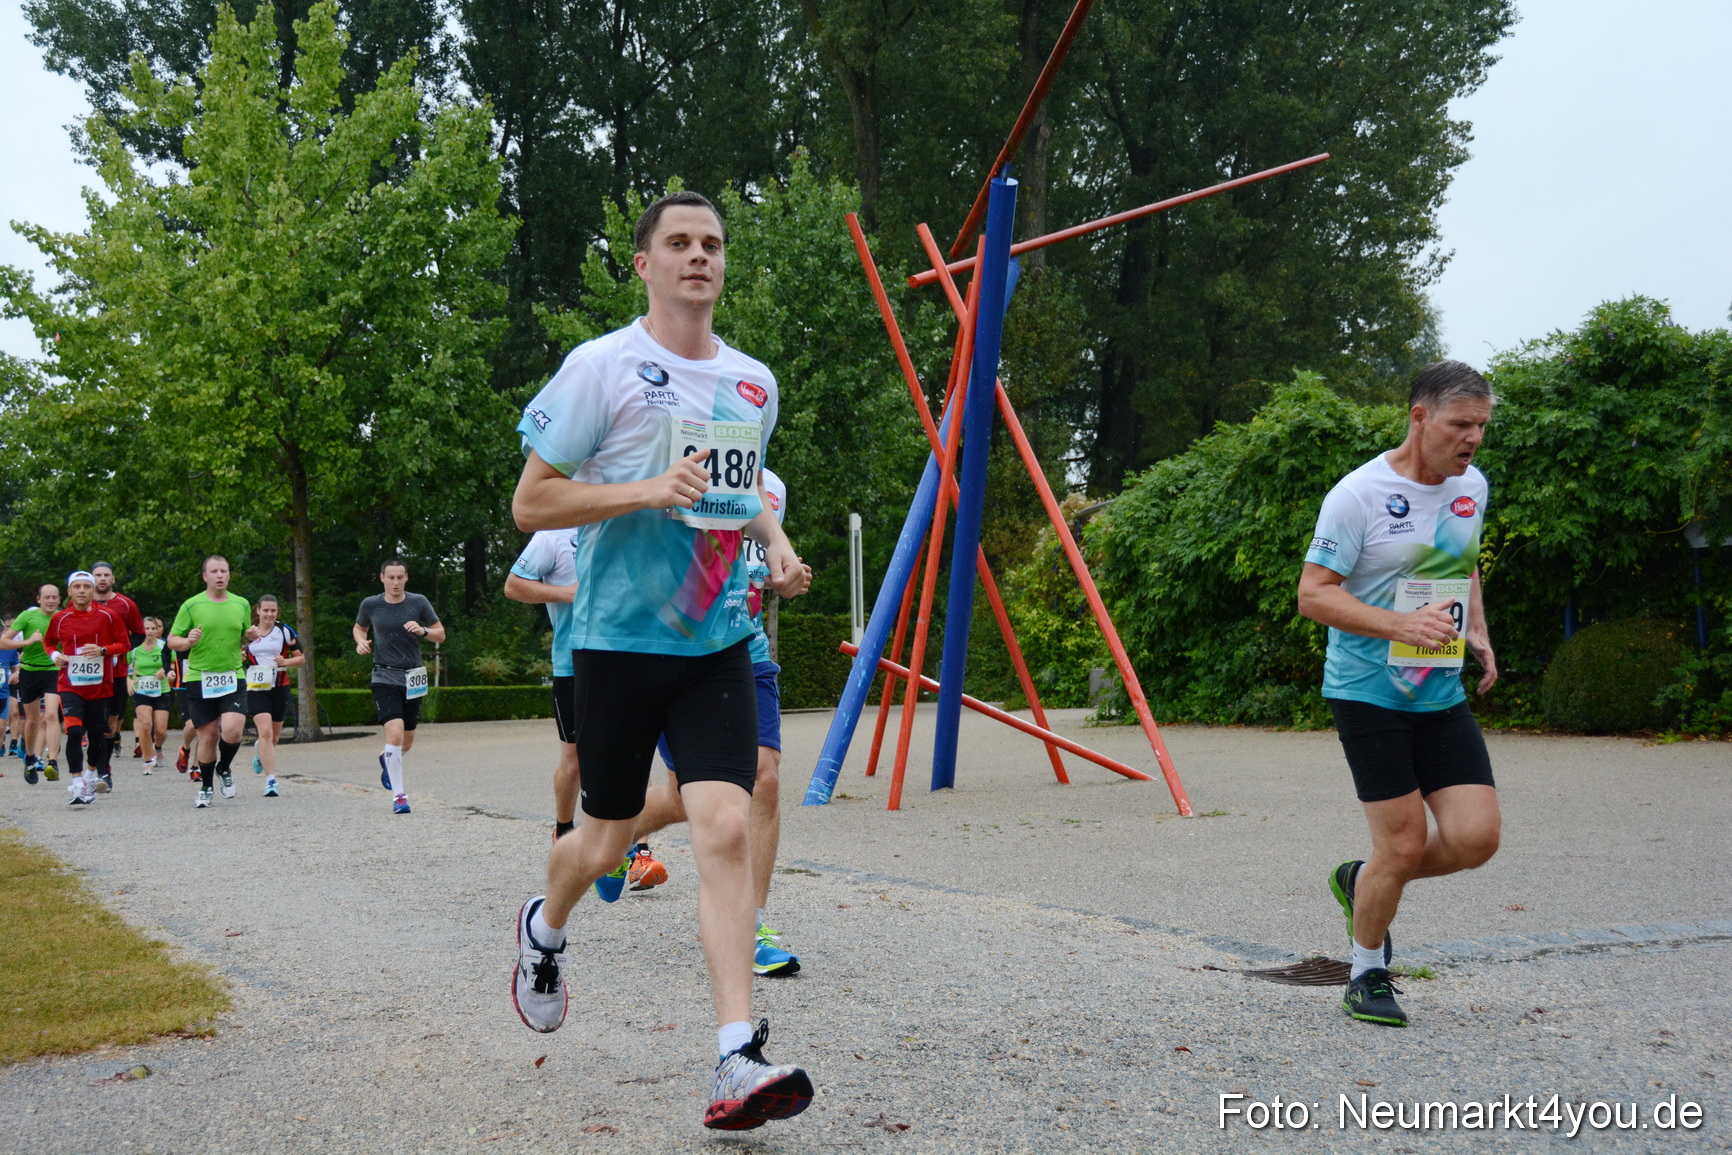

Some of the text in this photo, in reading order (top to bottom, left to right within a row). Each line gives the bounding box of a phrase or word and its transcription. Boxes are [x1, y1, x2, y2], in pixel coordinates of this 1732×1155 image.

[643, 390, 679, 402] PARTL
[714, 425, 760, 441] BOCK
[691, 498, 747, 515] Christian
[1389, 521, 1415, 530] PARTL
[1389, 528, 1416, 536] Neumarkt
[1436, 582, 1470, 594] BOCK
[71, 662, 101, 675] 2462
[205, 675, 234, 688] 2384
[253, 671, 264, 682] 18
[409, 674, 427, 688] 308
[140, 680, 159, 690] 2454
